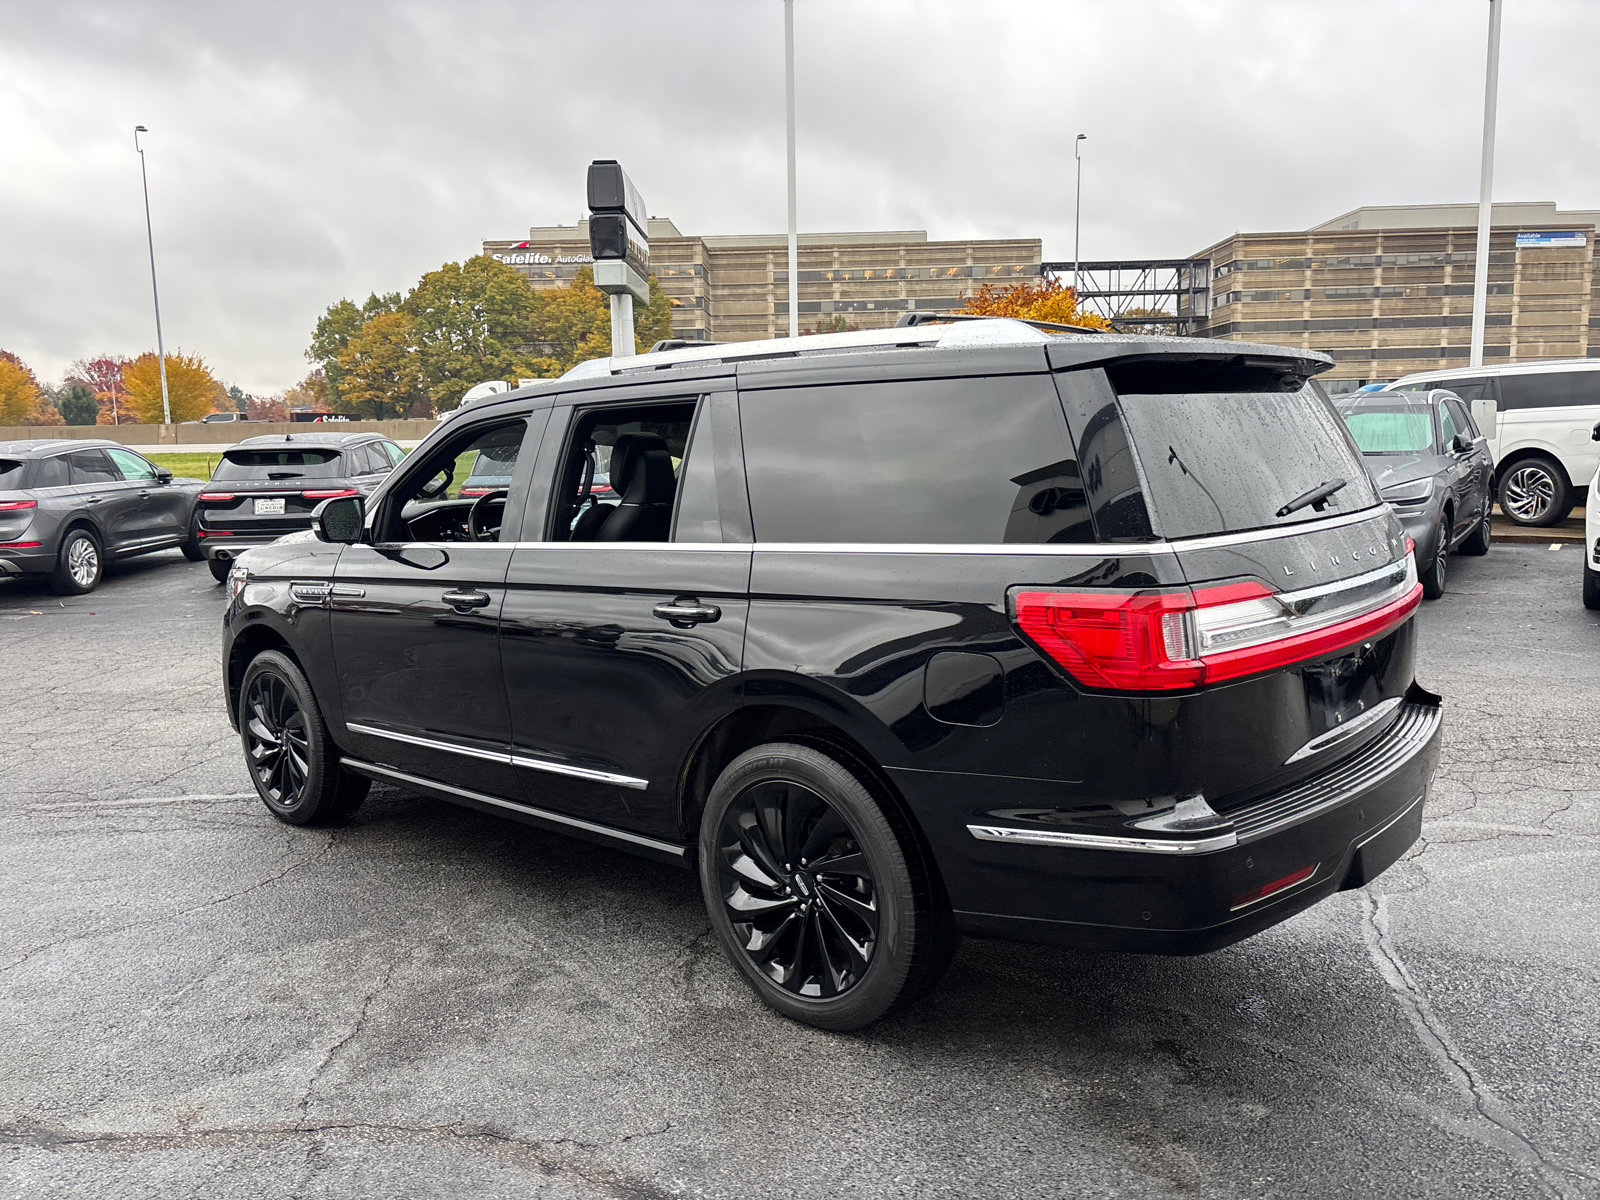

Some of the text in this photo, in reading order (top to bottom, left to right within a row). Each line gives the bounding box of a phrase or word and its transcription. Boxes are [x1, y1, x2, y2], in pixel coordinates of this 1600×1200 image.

[492, 253, 596, 264] Safelite AutoGlas
[1283, 538, 1398, 576] LINCOLN
